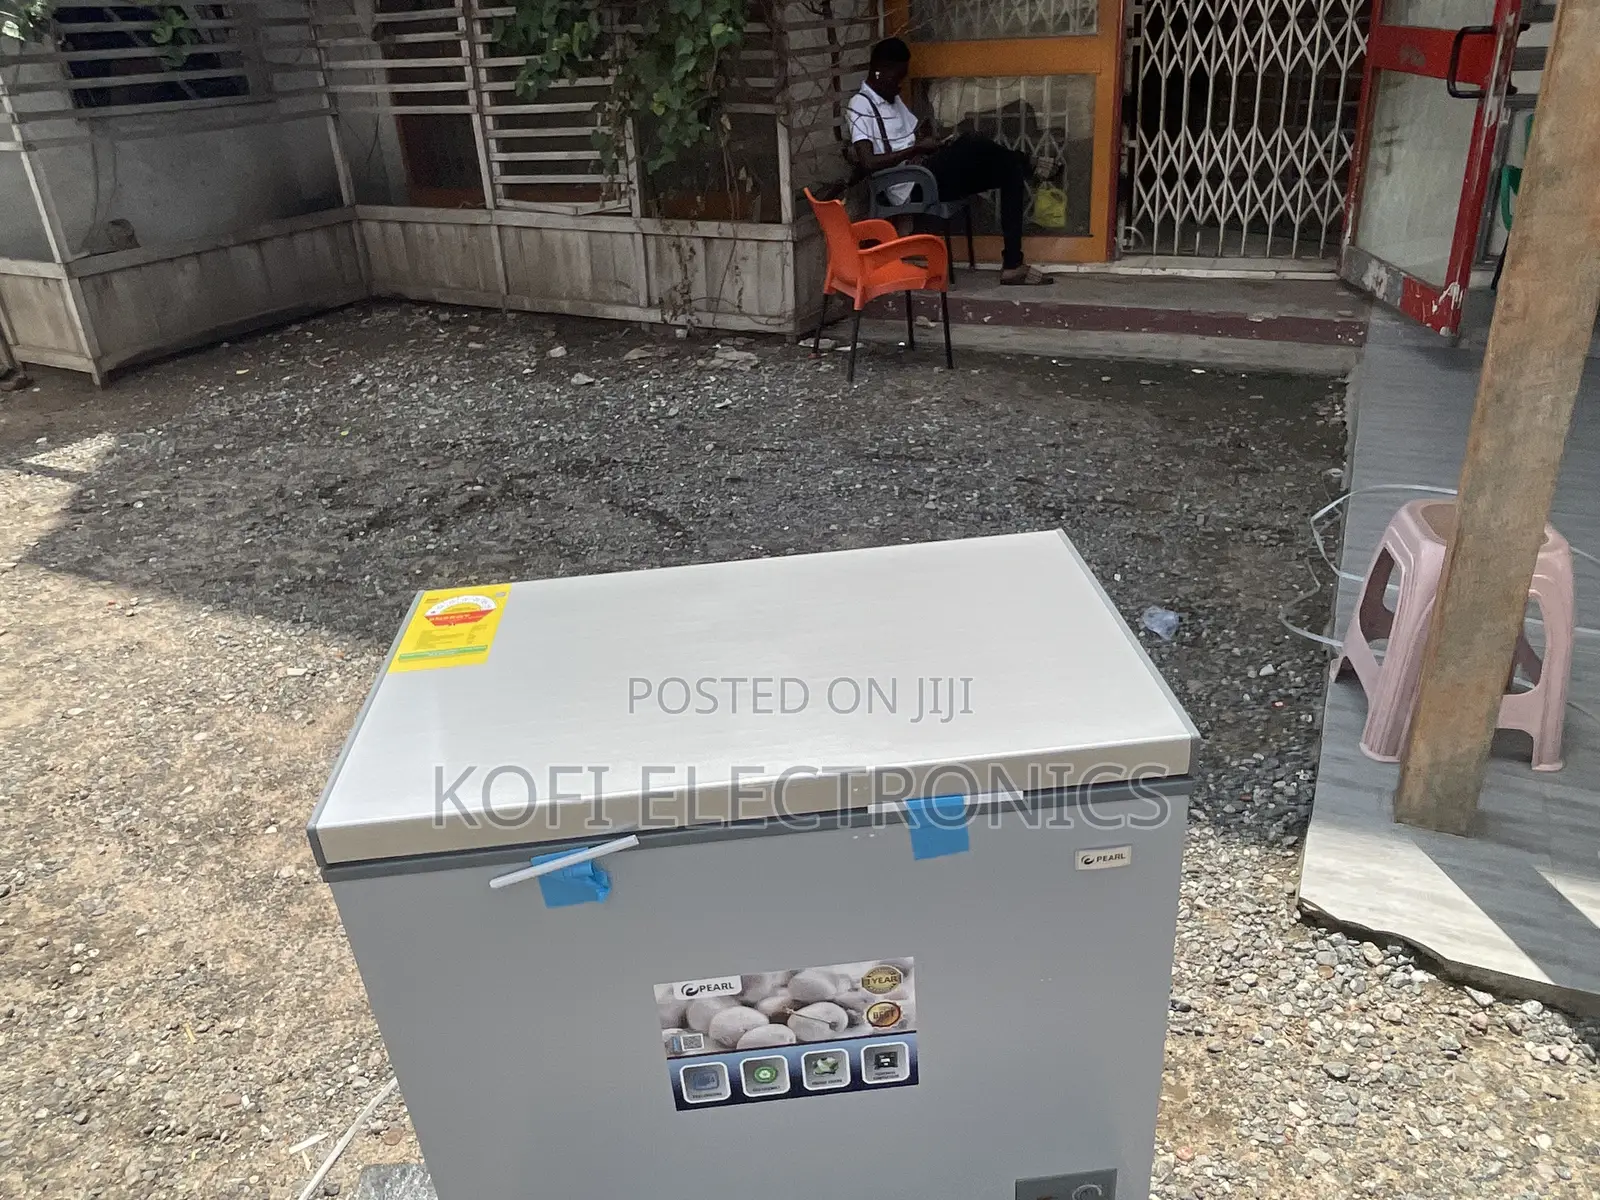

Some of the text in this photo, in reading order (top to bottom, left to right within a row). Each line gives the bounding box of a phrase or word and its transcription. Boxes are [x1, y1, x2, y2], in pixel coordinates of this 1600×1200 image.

[1096, 853, 1126, 862] PEARL
[871, 976, 898, 984] YEAR
[699, 982, 734, 993] PEARL
